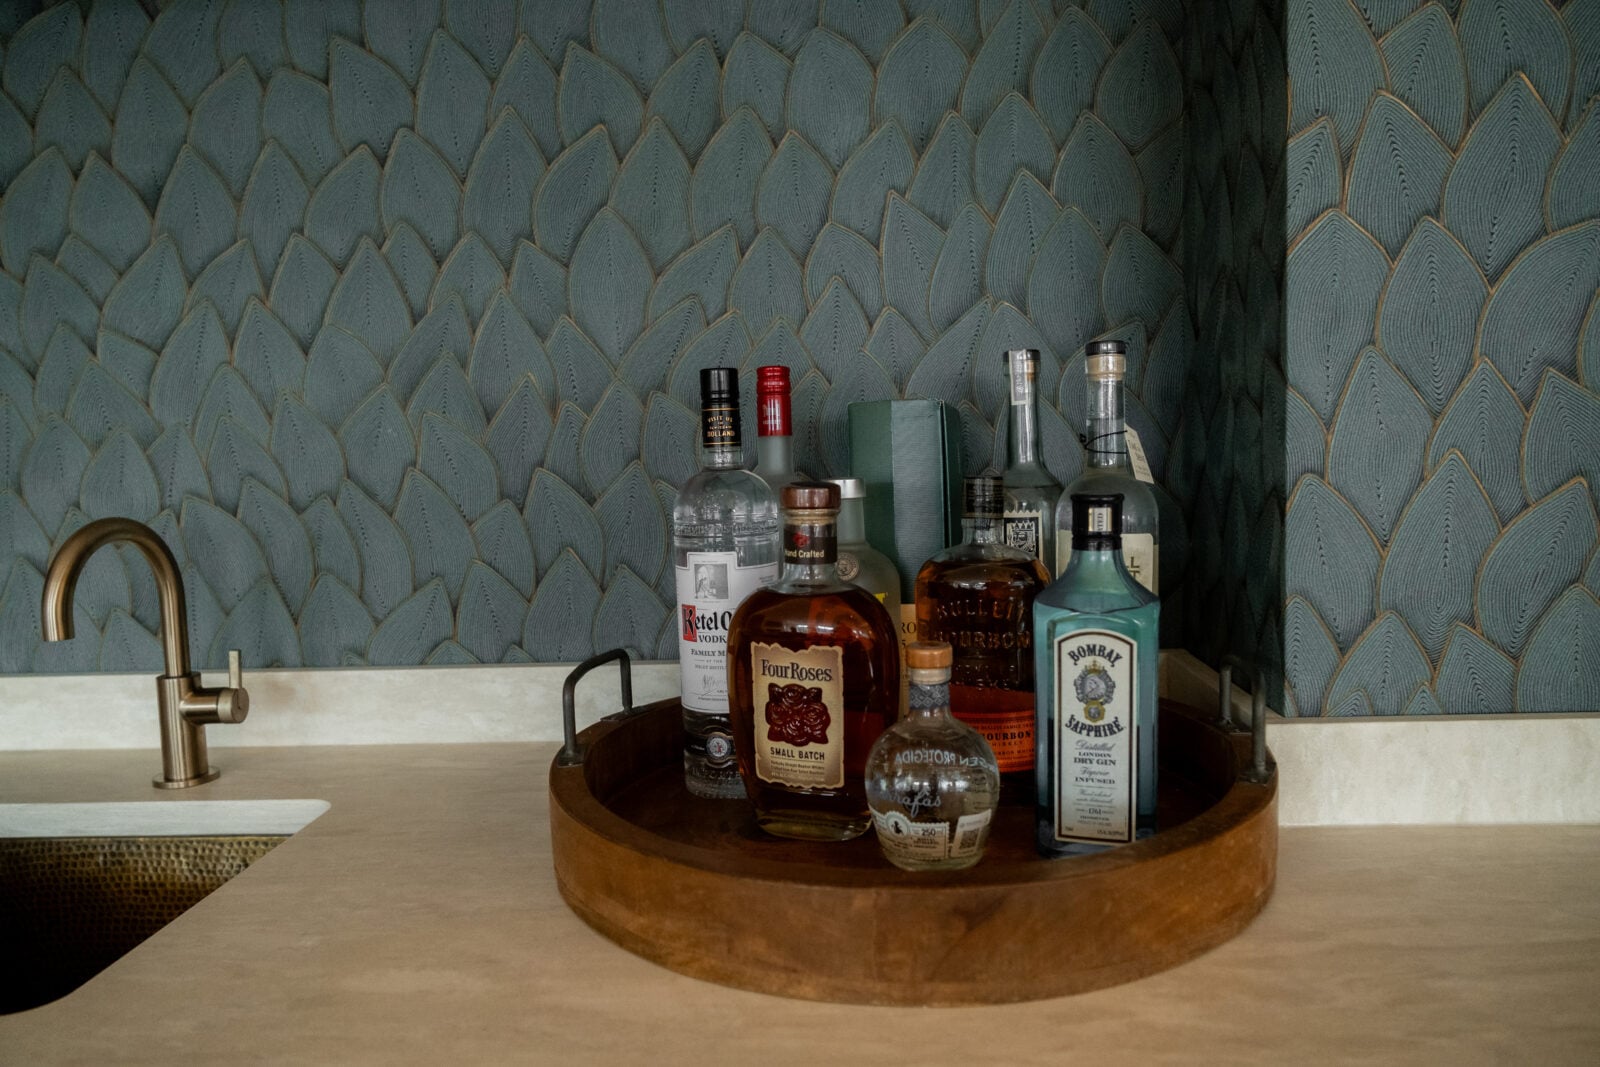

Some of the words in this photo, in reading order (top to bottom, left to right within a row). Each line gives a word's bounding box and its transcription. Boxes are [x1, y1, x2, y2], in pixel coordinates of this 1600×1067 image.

[707, 430, 735, 438] HOLLAND
[798, 549, 825, 558] Crafted
[682, 607, 719, 636] Ketel
[698, 635, 727, 643] VODK
[690, 648, 717, 656] FAMILY
[1067, 644, 1123, 667] BOMBAY
[761, 658, 790, 679] Four
[790, 662, 833, 681] Roses
[1065, 714, 1124, 737] SAPPHIRE
[983, 731, 1031, 741] OURBON
[770, 747, 795, 758] SMALL
[798, 751, 825, 760] BATCH
[921, 828, 936, 836] 250
